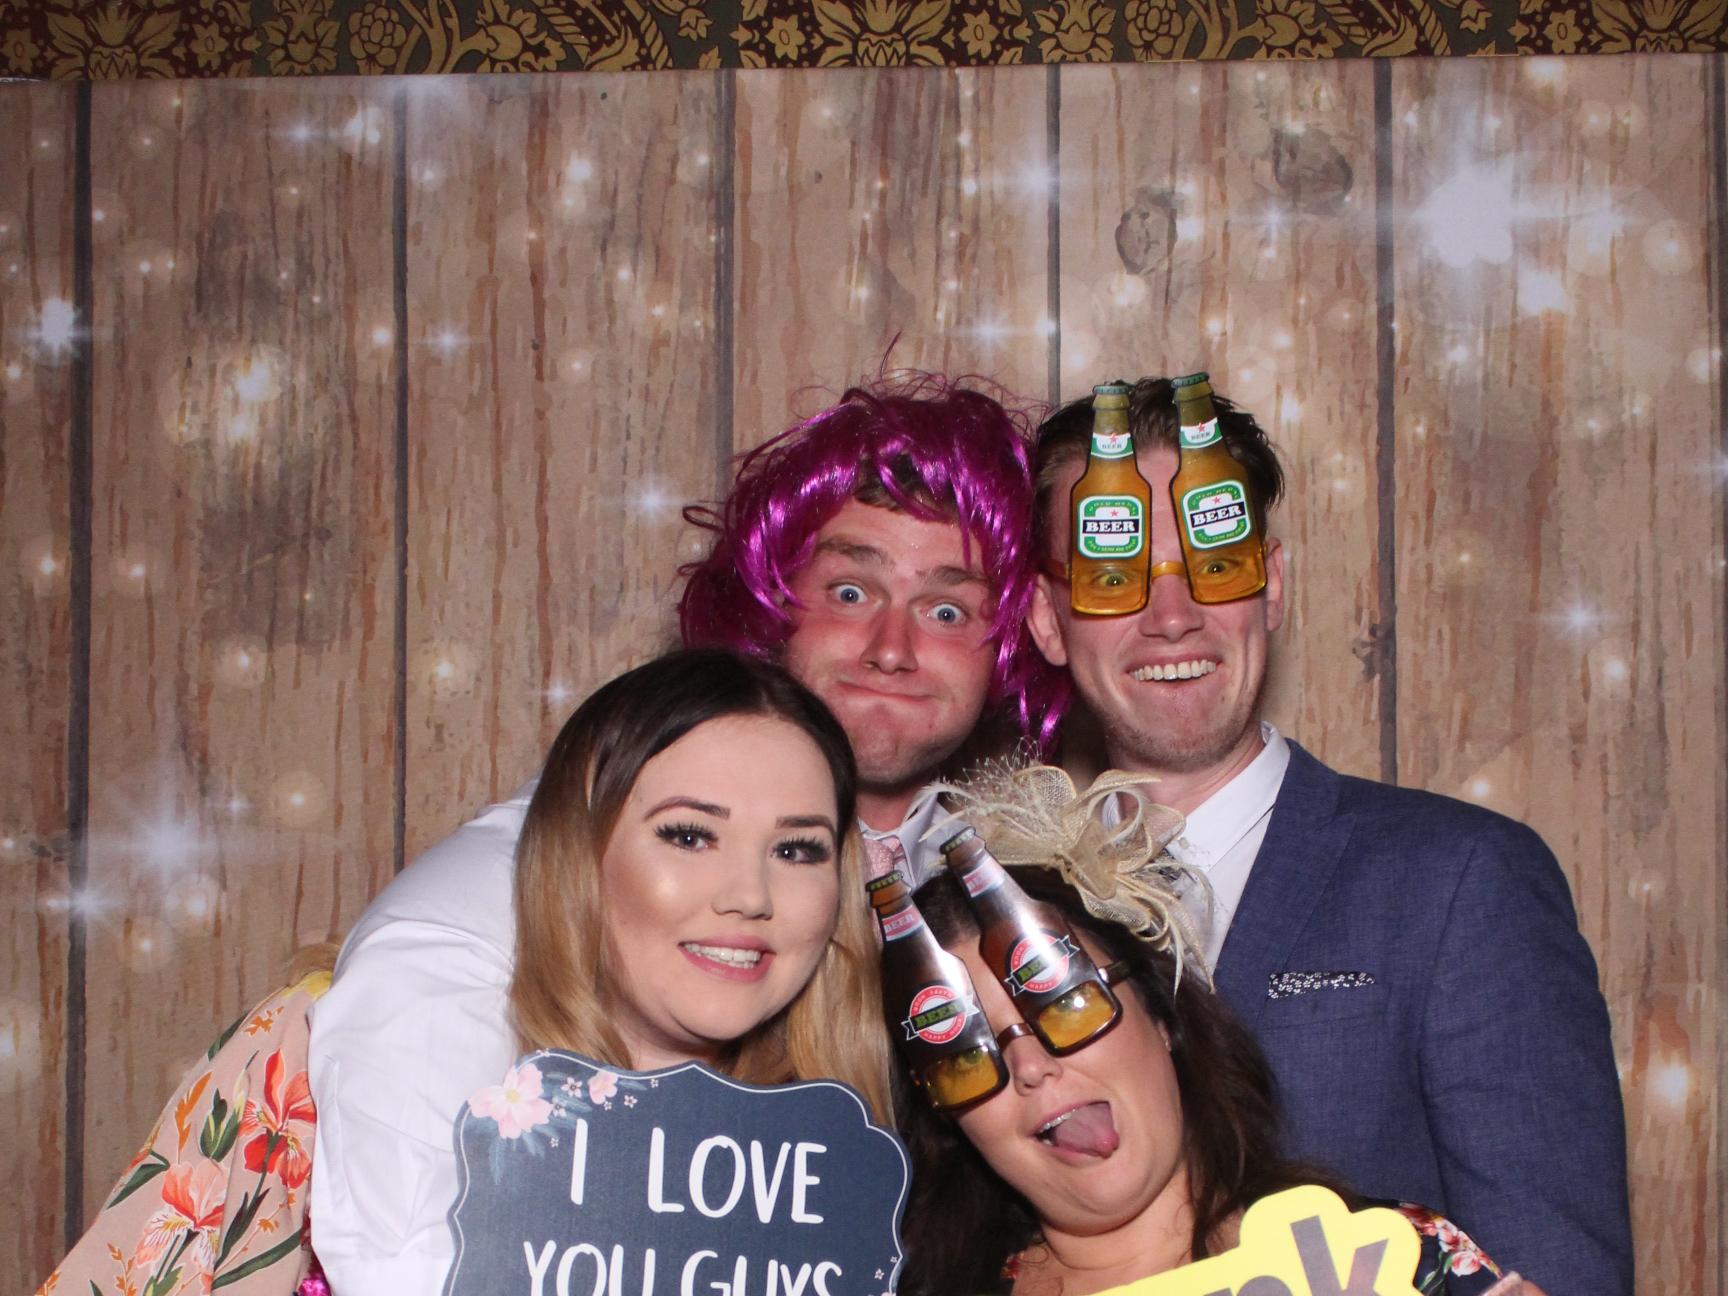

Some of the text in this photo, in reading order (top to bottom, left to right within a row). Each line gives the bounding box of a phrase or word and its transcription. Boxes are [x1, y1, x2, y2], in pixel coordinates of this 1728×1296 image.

[1193, 505, 1242, 526] BEER
[1085, 521, 1135, 533] BEER
[570, 1118, 828, 1224] I LOVE
